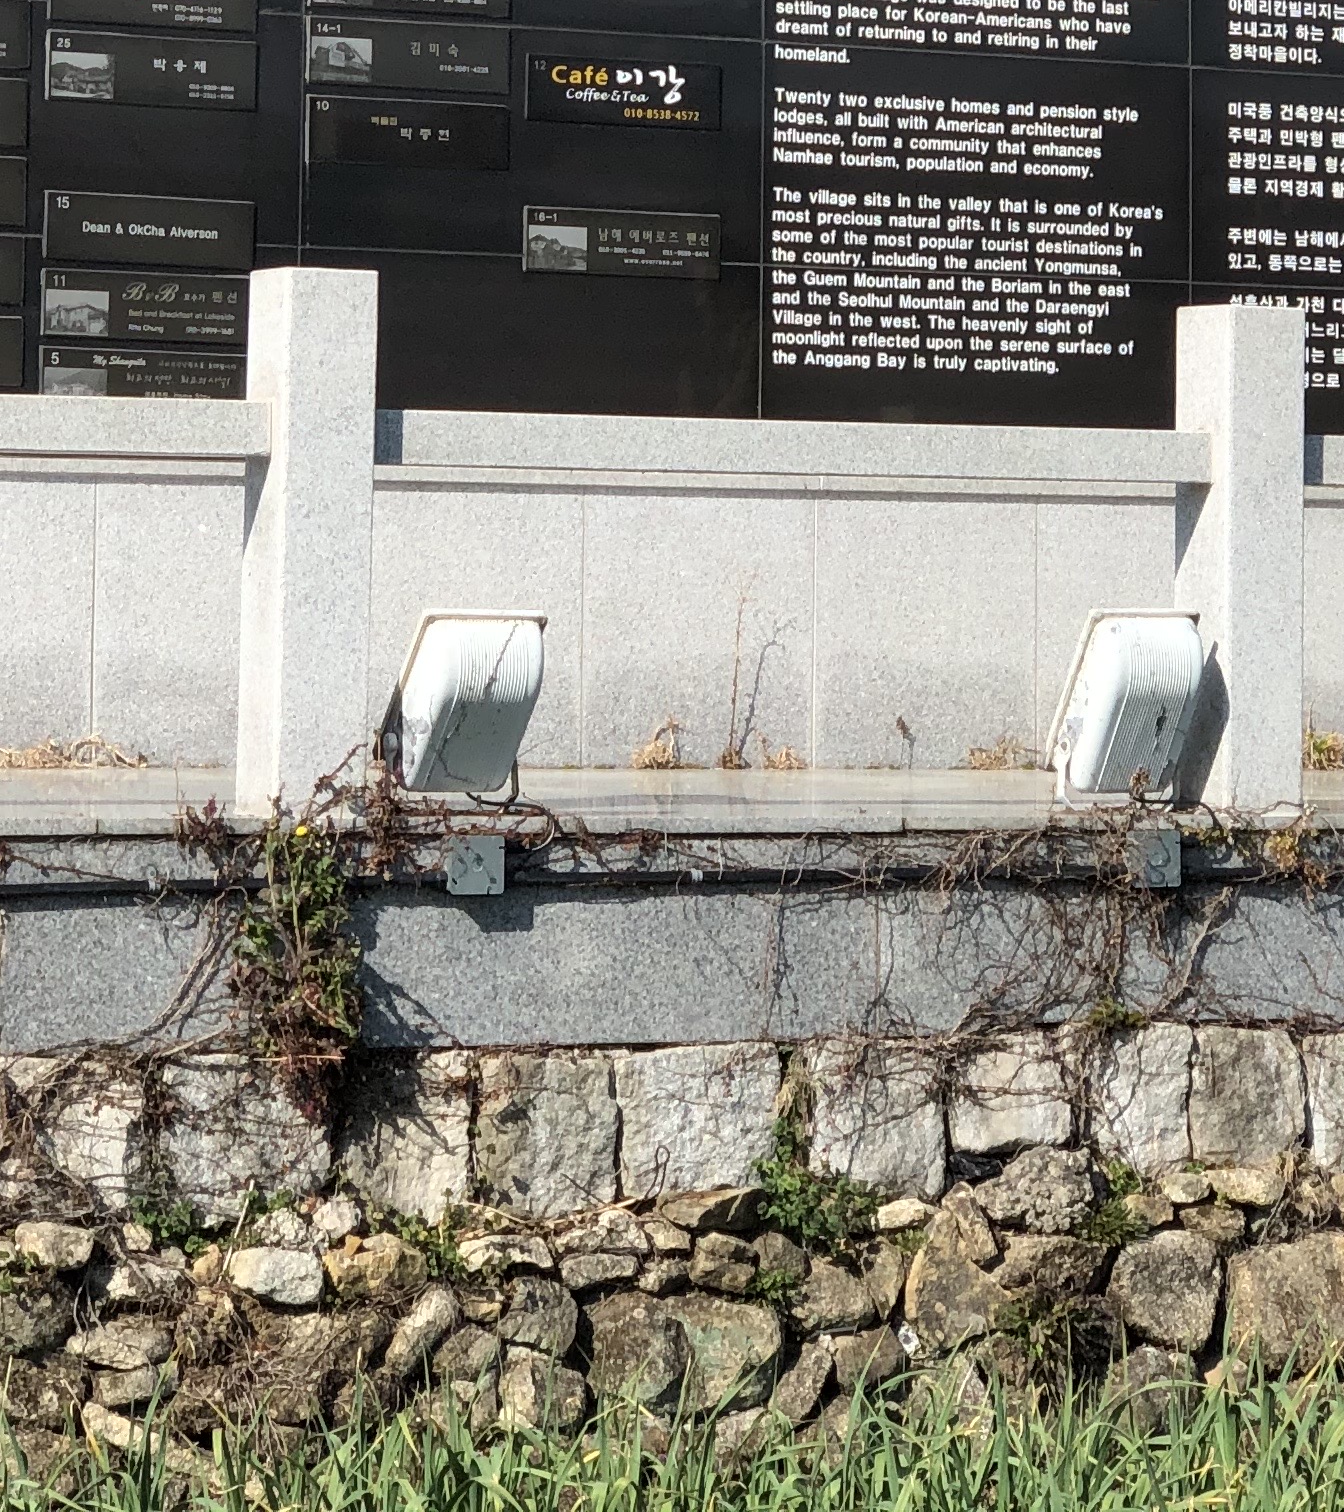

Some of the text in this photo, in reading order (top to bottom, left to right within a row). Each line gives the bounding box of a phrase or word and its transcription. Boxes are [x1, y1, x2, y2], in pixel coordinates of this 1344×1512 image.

[1101, 0, 1129, 16] last
[317, 23, 340, 33] 14-1
[1228, 20, 1288, 40] 보내고자
[1295, 24, 1325, 42] 하는
[535, 60, 546, 70] 12
[552, 66, 608, 85] Café
[317, 101, 329, 110] 10
[774, 87, 1139, 124] Twenty two exclusive homes and pension style
[1227, 176, 1257, 195] 물론
[1264, 178, 1324, 198] 지역경제
[57, 196, 69, 208] 15
[83, 221, 110, 233] Dean
[53, 275, 65, 286] 11
[772, 290, 800, 305] and
[807, 290, 832, 306] the
[899, 293, 966, 311] Mountain
[972, 297, 999, 312] and
[1005, 297, 1029, 314] the
[51, 352, 59, 364] 5
[772, 348, 1059, 375] the Anggang Bay is truly captivating.
